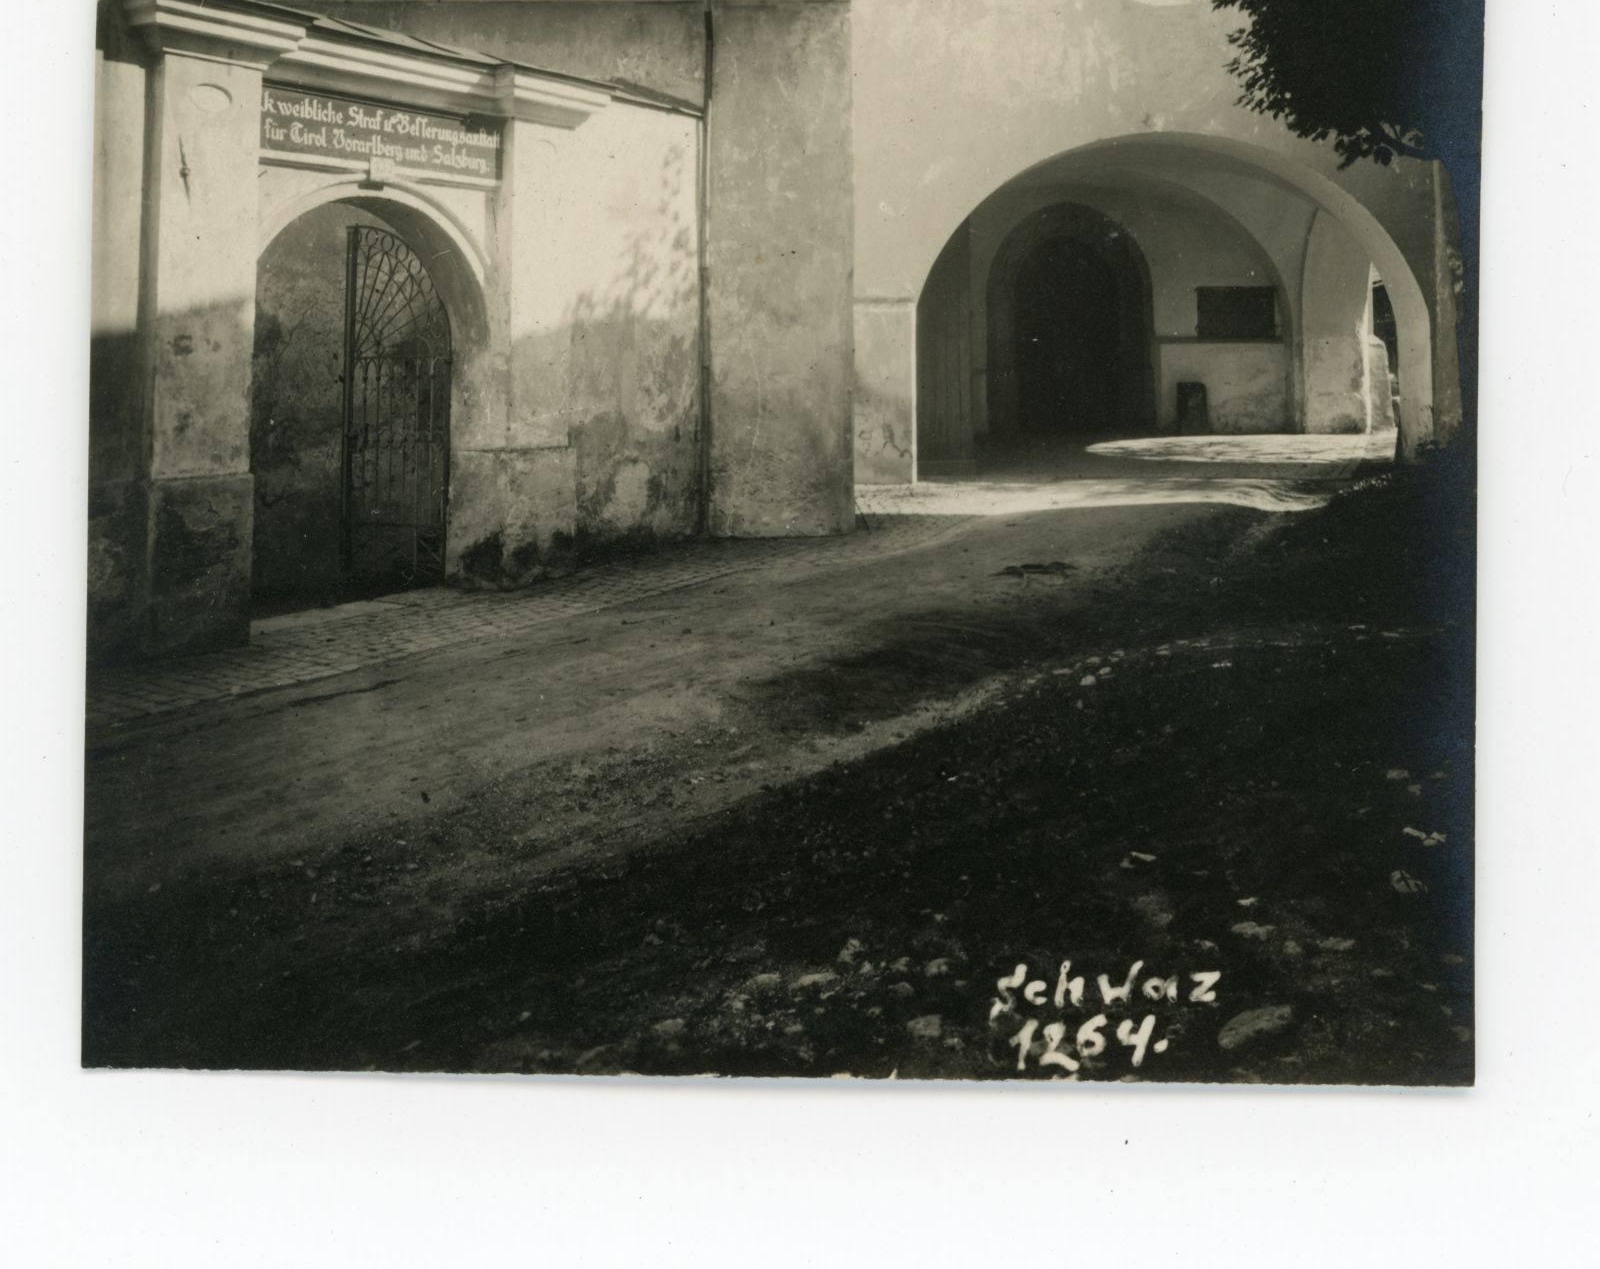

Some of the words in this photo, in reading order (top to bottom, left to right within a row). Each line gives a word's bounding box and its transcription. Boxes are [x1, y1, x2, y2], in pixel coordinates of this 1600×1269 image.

[277, 98, 343, 124] weibliche
[346, 106, 384, 131] Straf
[264, 117, 288, 141] für
[290, 121, 327, 147] Tirol
[332, 128, 403, 162] Vorarlberg
[405, 144, 428, 162] und
